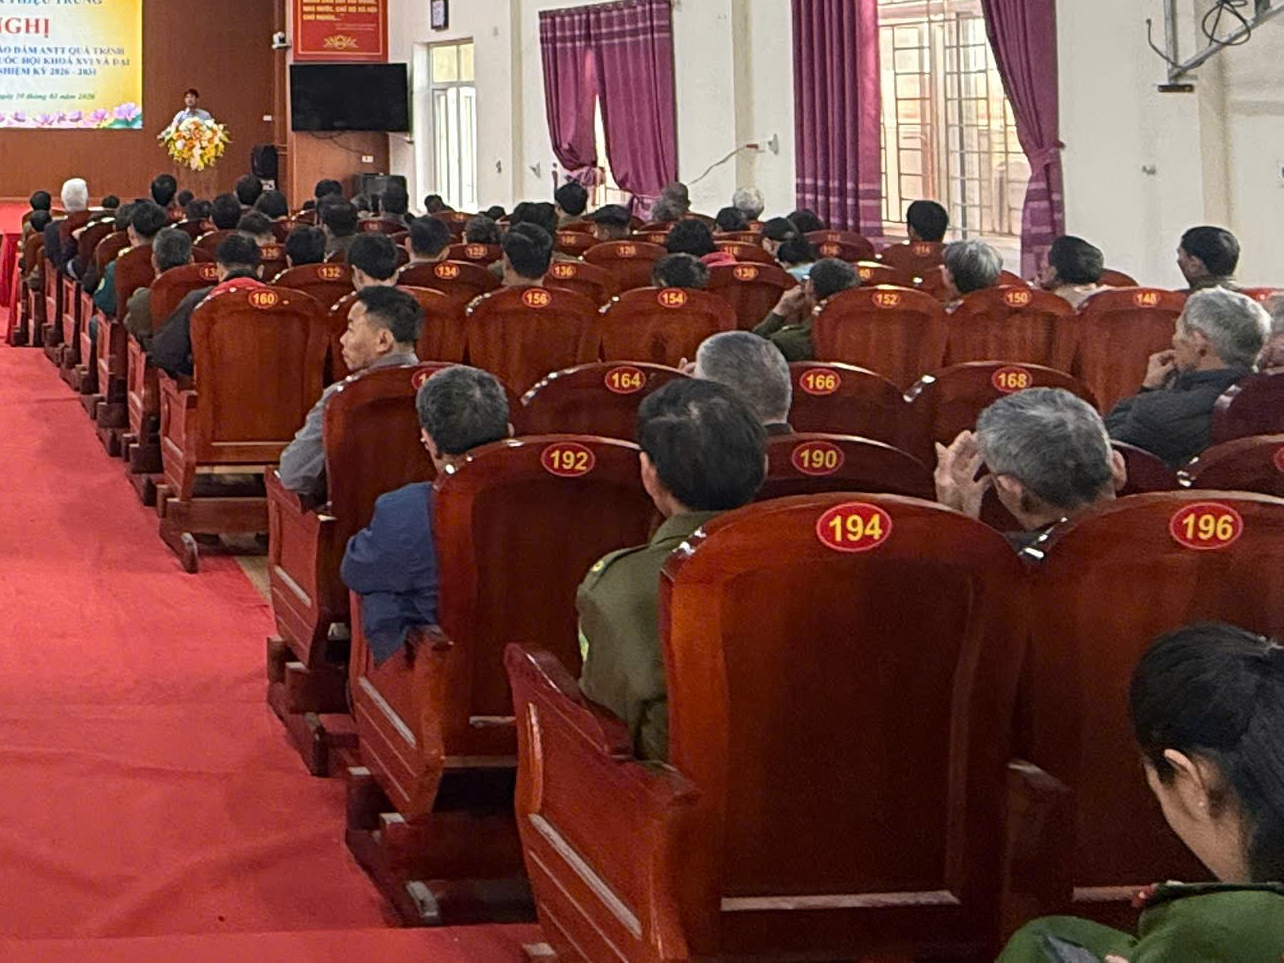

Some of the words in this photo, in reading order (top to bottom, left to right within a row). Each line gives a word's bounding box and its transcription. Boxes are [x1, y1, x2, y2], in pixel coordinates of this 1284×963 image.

[322, 267, 341, 278] 132
[253, 293, 274, 304] 160
[526, 293, 548, 305] 156
[662, 293, 683, 305] 154
[876, 294, 897, 306] 152
[1007, 292, 1028, 304] 150
[611, 372, 641, 387] 164
[806, 374, 835, 388] 166
[997, 372, 1027, 387] 168
[549, 451, 587, 470] 192
[800, 449, 837, 468] 190
[829, 513, 883, 542] 194
[1182, 514, 1234, 543] 196
